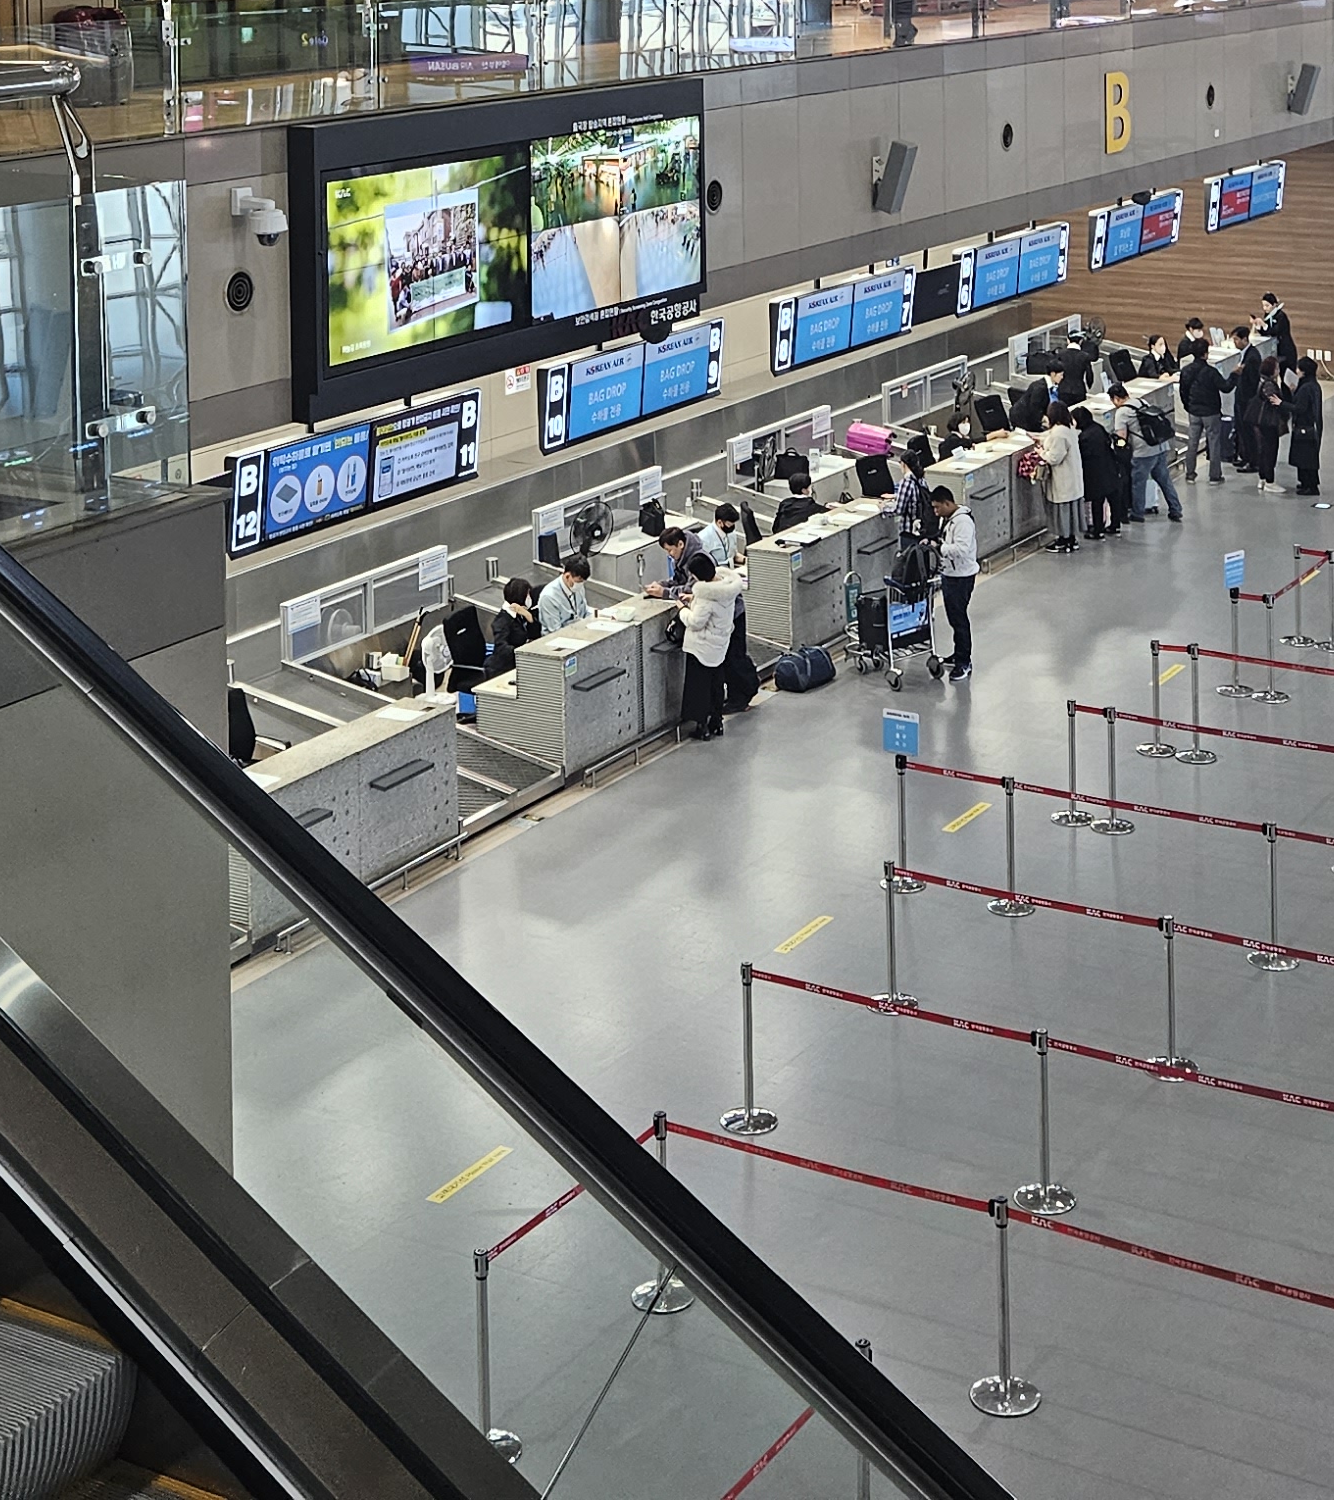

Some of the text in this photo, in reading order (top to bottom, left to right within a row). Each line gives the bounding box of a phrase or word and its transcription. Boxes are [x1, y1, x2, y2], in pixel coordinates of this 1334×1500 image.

[1104, 71, 1132, 154] B
[650, 299, 697, 325] 한국공항공사
[781, 307, 791, 332] B
[865, 301, 893, 320] BAG DROP
[901, 304, 910, 324] 7
[809, 316, 840, 336] BAG DROP
[658, 336, 693, 354] KOREAN AIR
[710, 327, 721, 353] B
[585, 357, 625, 376] KOREAN AIR
[660, 360, 695, 383] BAG DROP
[708, 360, 718, 385] 9
[550, 374, 564, 403] B
[588, 381, 627, 406] BAG DROP
[461, 400, 477, 430] B
[548, 414, 563, 438] 10
[460, 441, 475, 467] 11
[240, 464, 258, 497] B
[237, 511, 257, 539] 12
